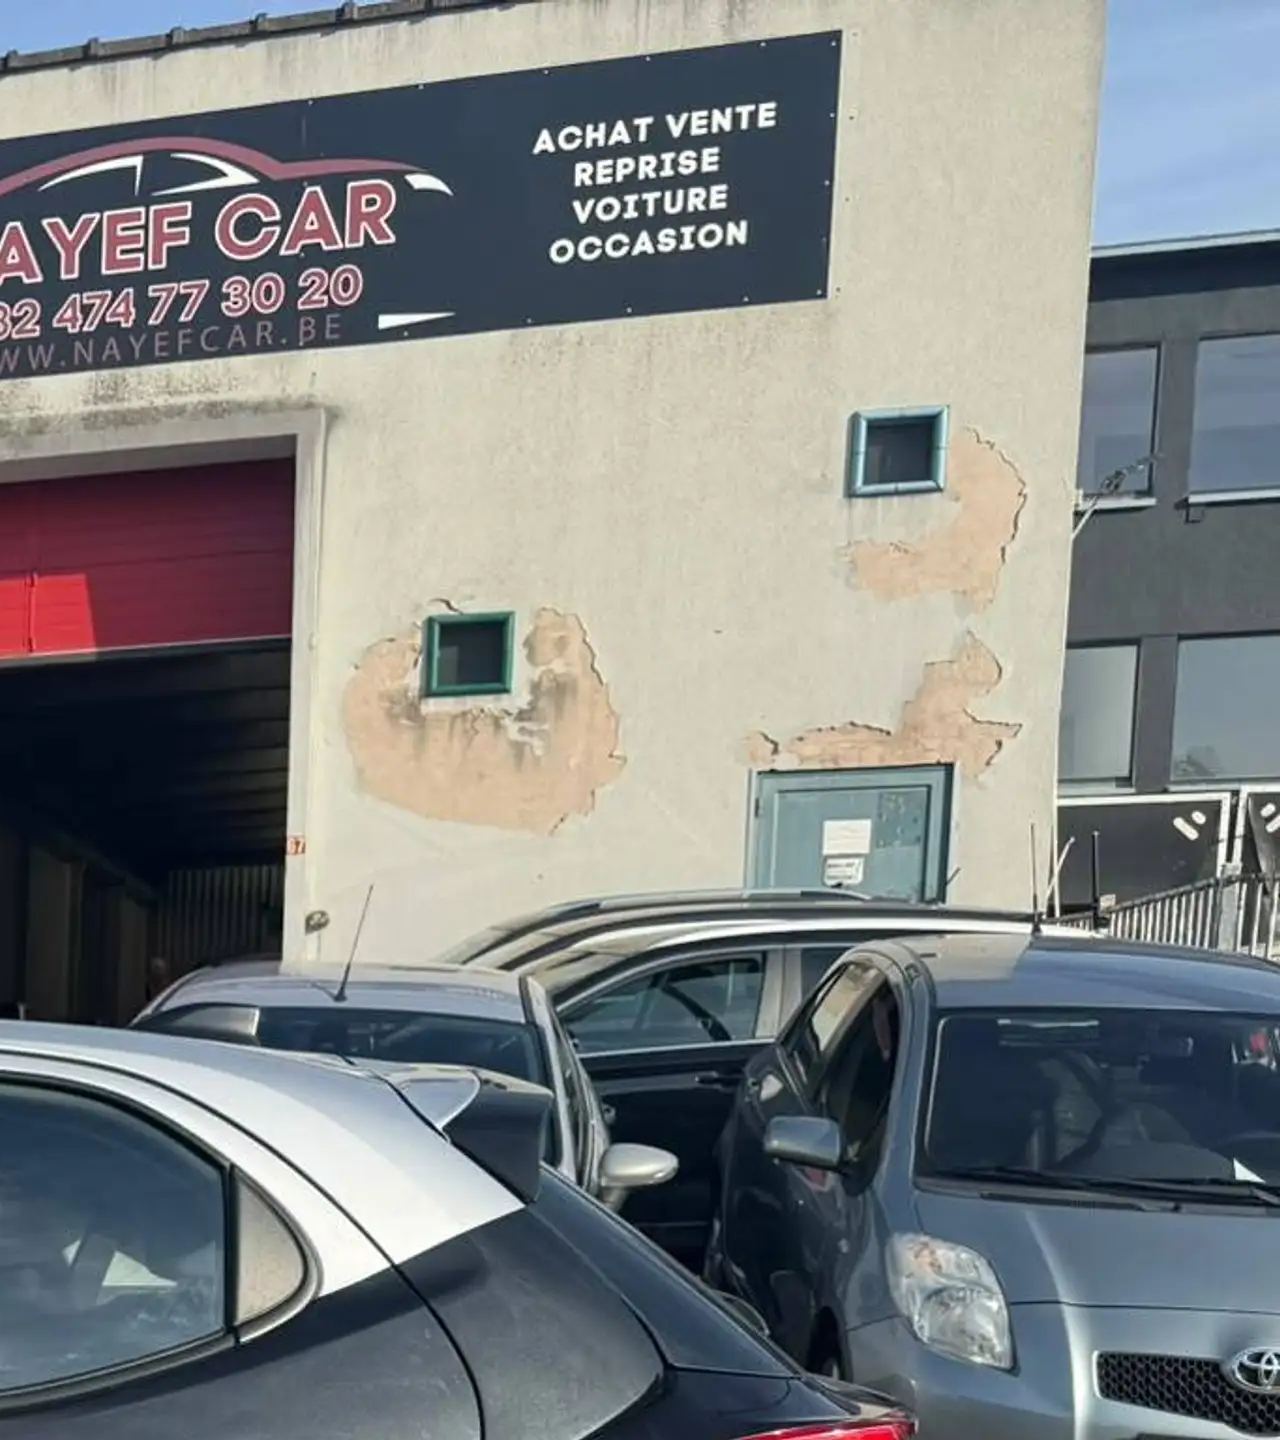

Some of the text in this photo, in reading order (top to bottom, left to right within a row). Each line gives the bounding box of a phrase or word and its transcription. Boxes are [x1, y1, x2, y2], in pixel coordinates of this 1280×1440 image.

[532, 101, 778, 154] ACHAT VENTE
[573, 147, 721, 187] REPRISE
[214, 180, 398, 258] CAR
[572, 184, 729, 224] VOITURE
[548, 220, 749, 264] OCCASION
[52, 288, 137, 333] 474
[148, 280, 211, 326] 77
[220, 271, 286, 318] 30
[297, 264, 363, 310] 20
